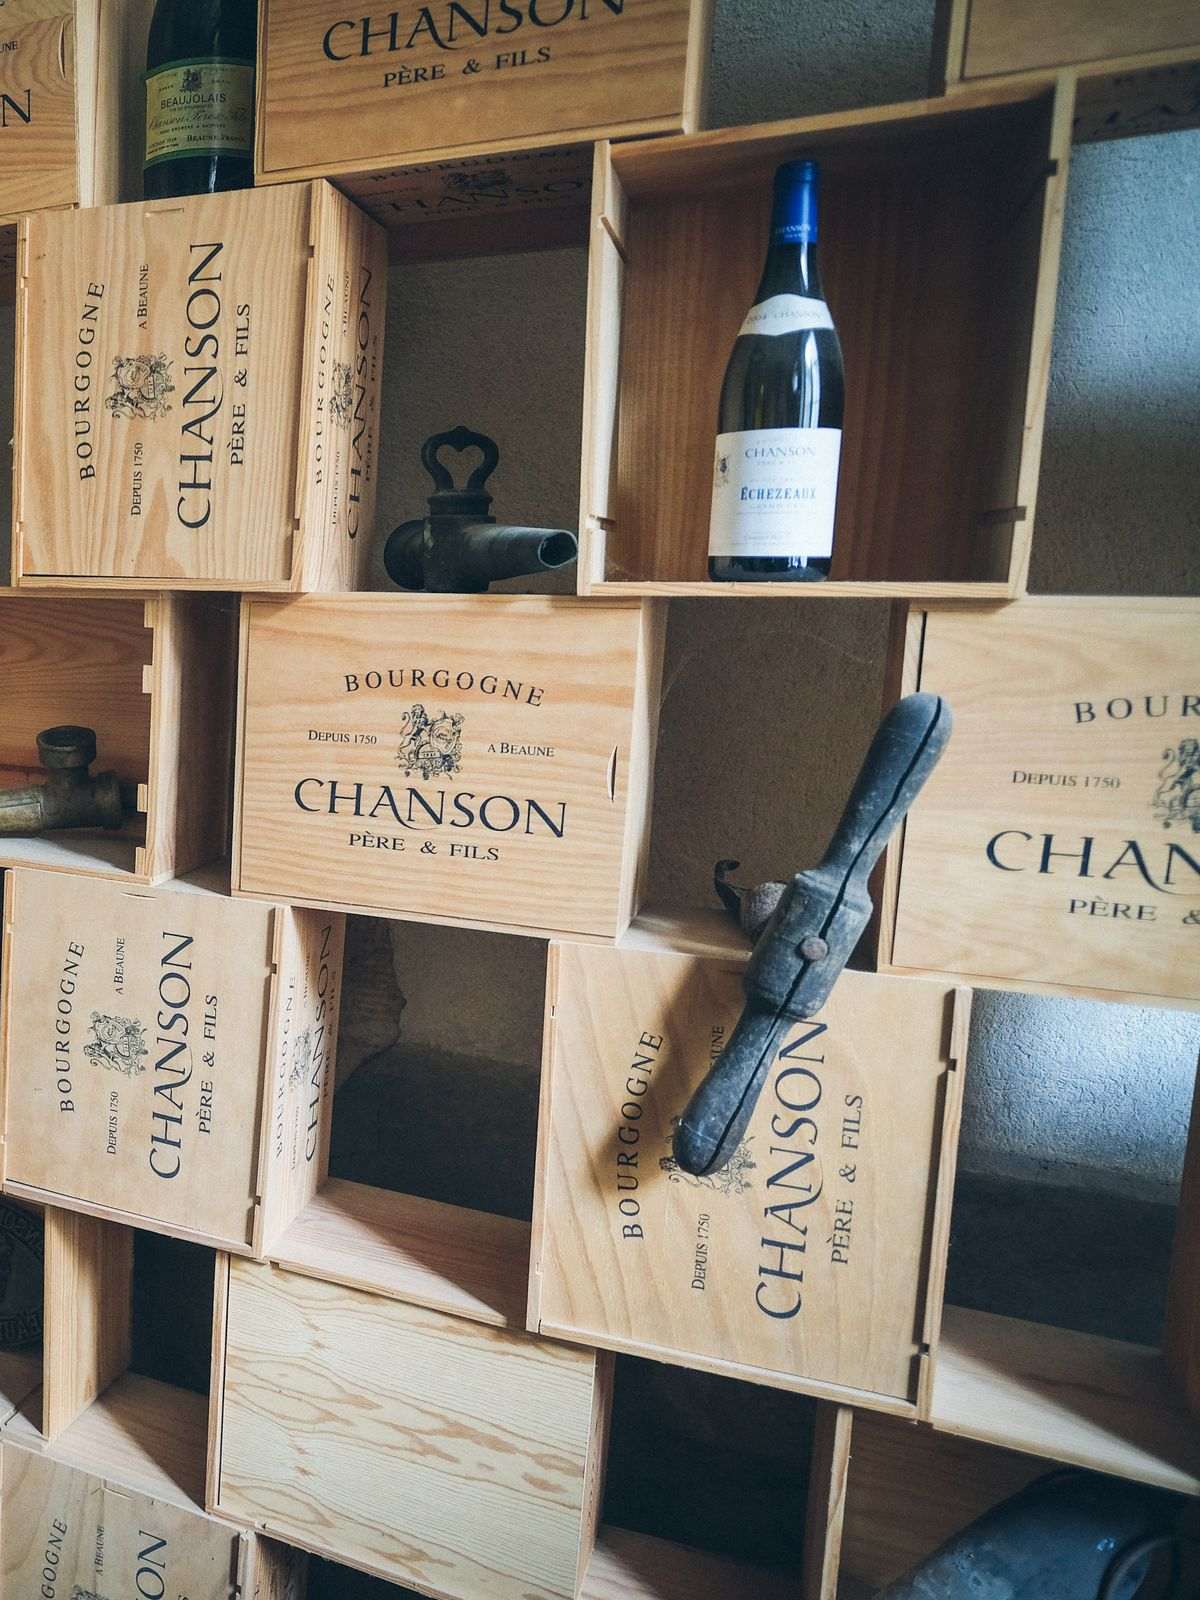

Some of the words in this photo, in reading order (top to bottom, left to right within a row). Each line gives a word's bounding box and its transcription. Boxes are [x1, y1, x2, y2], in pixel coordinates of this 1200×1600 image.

[383, 64, 446, 88] PÈRE
[461, 58, 481, 75] &
[495, 46, 552, 71] FILS
[160, 92, 227, 111] BEAUJOLAIS
[136, 263, 150, 320] BEAUNE
[137, 320, 148, 331] A
[235, 303, 252, 358] FILS
[75, 281, 106, 482] BOURGOGNE
[176, 240, 225, 530] CHANSON
[233, 370, 248, 388] &
[315, 273, 336, 486] BOURGOGNE
[346, 265, 375, 541] CHANSON
[133, 441, 144, 467] 1750
[227, 403, 247, 466] PÈRE
[744, 446, 816, 459] CHANSON
[130, 467, 143, 517] DEPUIS
[343, 668, 545, 708] BOURGOGNE
[307, 729, 351, 744] DEPUIS
[353, 732, 378, 746] 1750
[487, 743, 497, 754] A
[499, 741, 556, 758] BEAUNE
[1012, 769, 1078, 788] DEPUIS
[1084, 775, 1121, 790] 1750
[293, 777, 568, 839] CHANSON
[348, 830, 406, 852] PÈRE
[420, 841, 438, 856] &
[449, 842, 500, 862] FILS
[1068, 895, 1159, 922] PÈRE
[114, 935, 126, 984] BEAUNE
[115, 986, 124, 995] A
[55, 940, 85, 1114] BOURGOGNE
[202, 994, 218, 1042] FILS
[149, 931, 194, 1180] CHANSON
[202, 1050, 215, 1067] &
[304, 924, 333, 1164] CHANSON
[109, 1090, 120, 1115] 1750
[193, 1079, 214, 1135] PÈRE
[841, 1093, 865, 1151] FILS
[106, 1118, 118, 1156] DEPUIS
[617, 1030, 664, 1241] BOURGOGNE
[754, 1017, 829, 1321] CHANSON
[838, 1163, 858, 1184] &
[696, 1212, 712, 1241] 1750
[824, 1198, 855, 1266] PÈRE
[690, 1242, 709, 1292] DEPUIS
